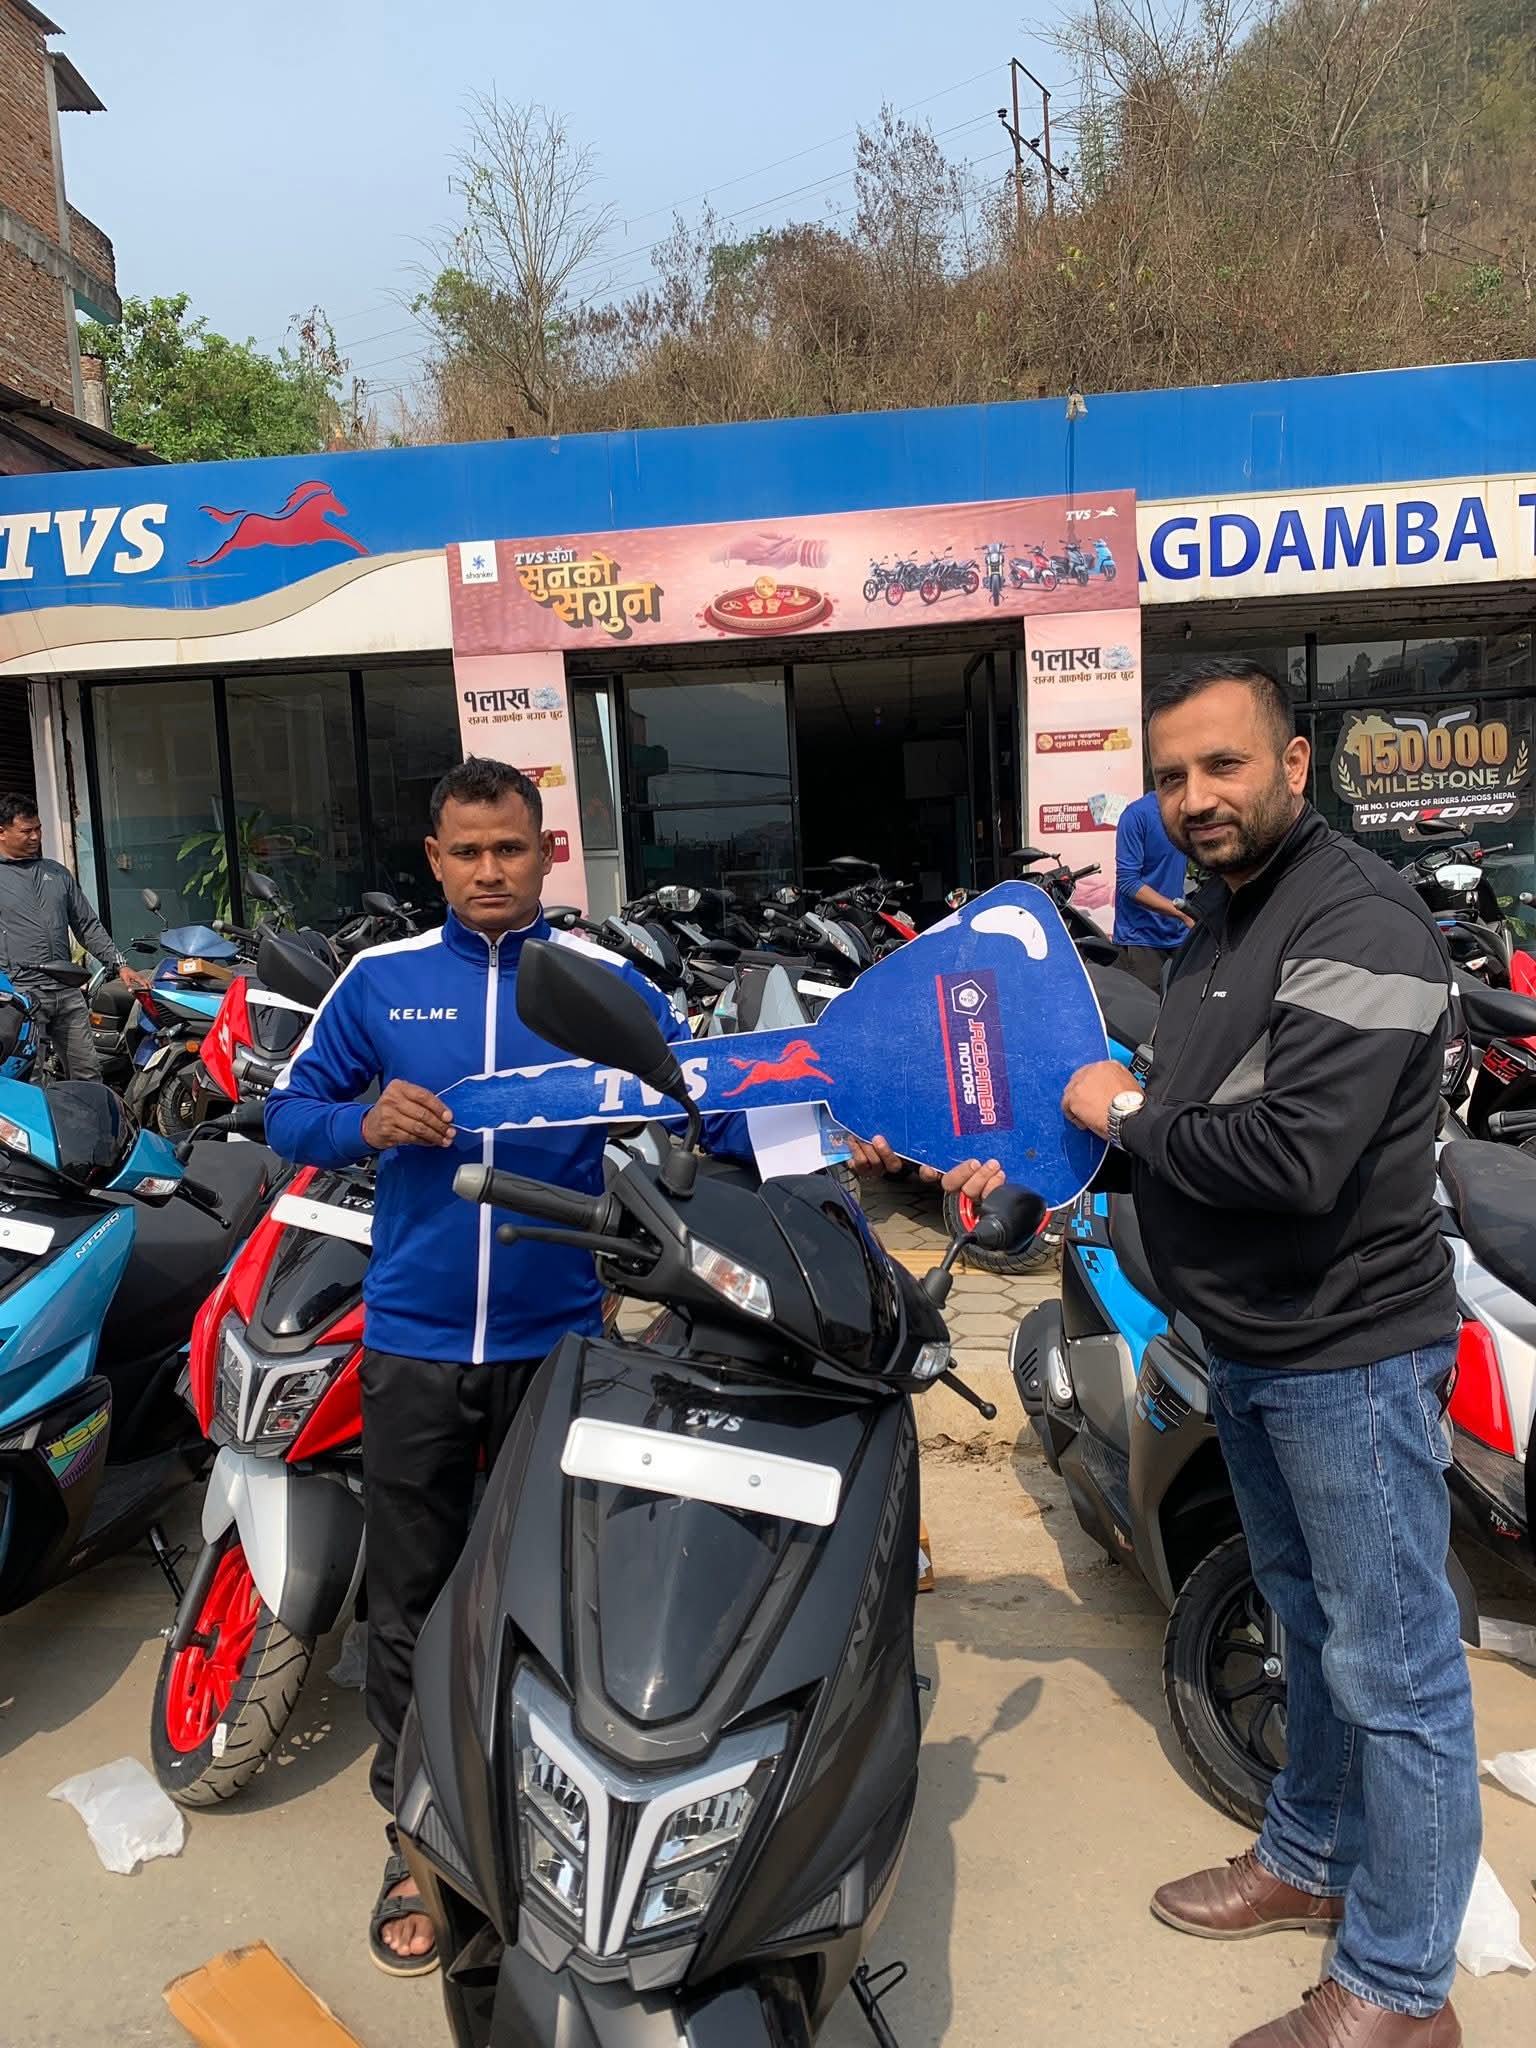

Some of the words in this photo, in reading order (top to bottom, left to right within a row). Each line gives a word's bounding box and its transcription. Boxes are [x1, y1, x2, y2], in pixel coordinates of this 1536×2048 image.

[1065, 509, 1091, 520] TVS
[0, 503, 168, 581] TVS
[1137, 497, 1497, 582] GDAMBA
[514, 552, 544, 565] TVS
[516, 551, 614, 602] सुनको
[550, 583, 656, 633] सगुन
[1358, 722, 1508, 776] 150000
[1365, 768, 1500, 796] MILESTONE
[1063, 804, 1088, 813] Finance
[1355, 803, 1369, 812] THE
[1370, 802, 1385, 811] NO.
[1391, 800, 1420, 809] CHOICE
[1421, 798, 1432, 806] OF
[1433, 796, 1460, 805] RIDERS
[1460, 793, 1492, 803] ACROSS
[1493, 791, 1517, 800] NEPAL
[1360, 812, 1388, 825] TVS
[1390, 802, 1514, 823] NTORQ
[389, 1007, 458, 1021] KELME
[957, 1042, 977, 1105] MOTORS
[968, 1018, 997, 1125] JAGDAMBA
[75, 1211, 120, 1259] NTORQ
[685, 1407, 745, 1432] TVS
[1490, 1509, 1508, 1531] TVS
